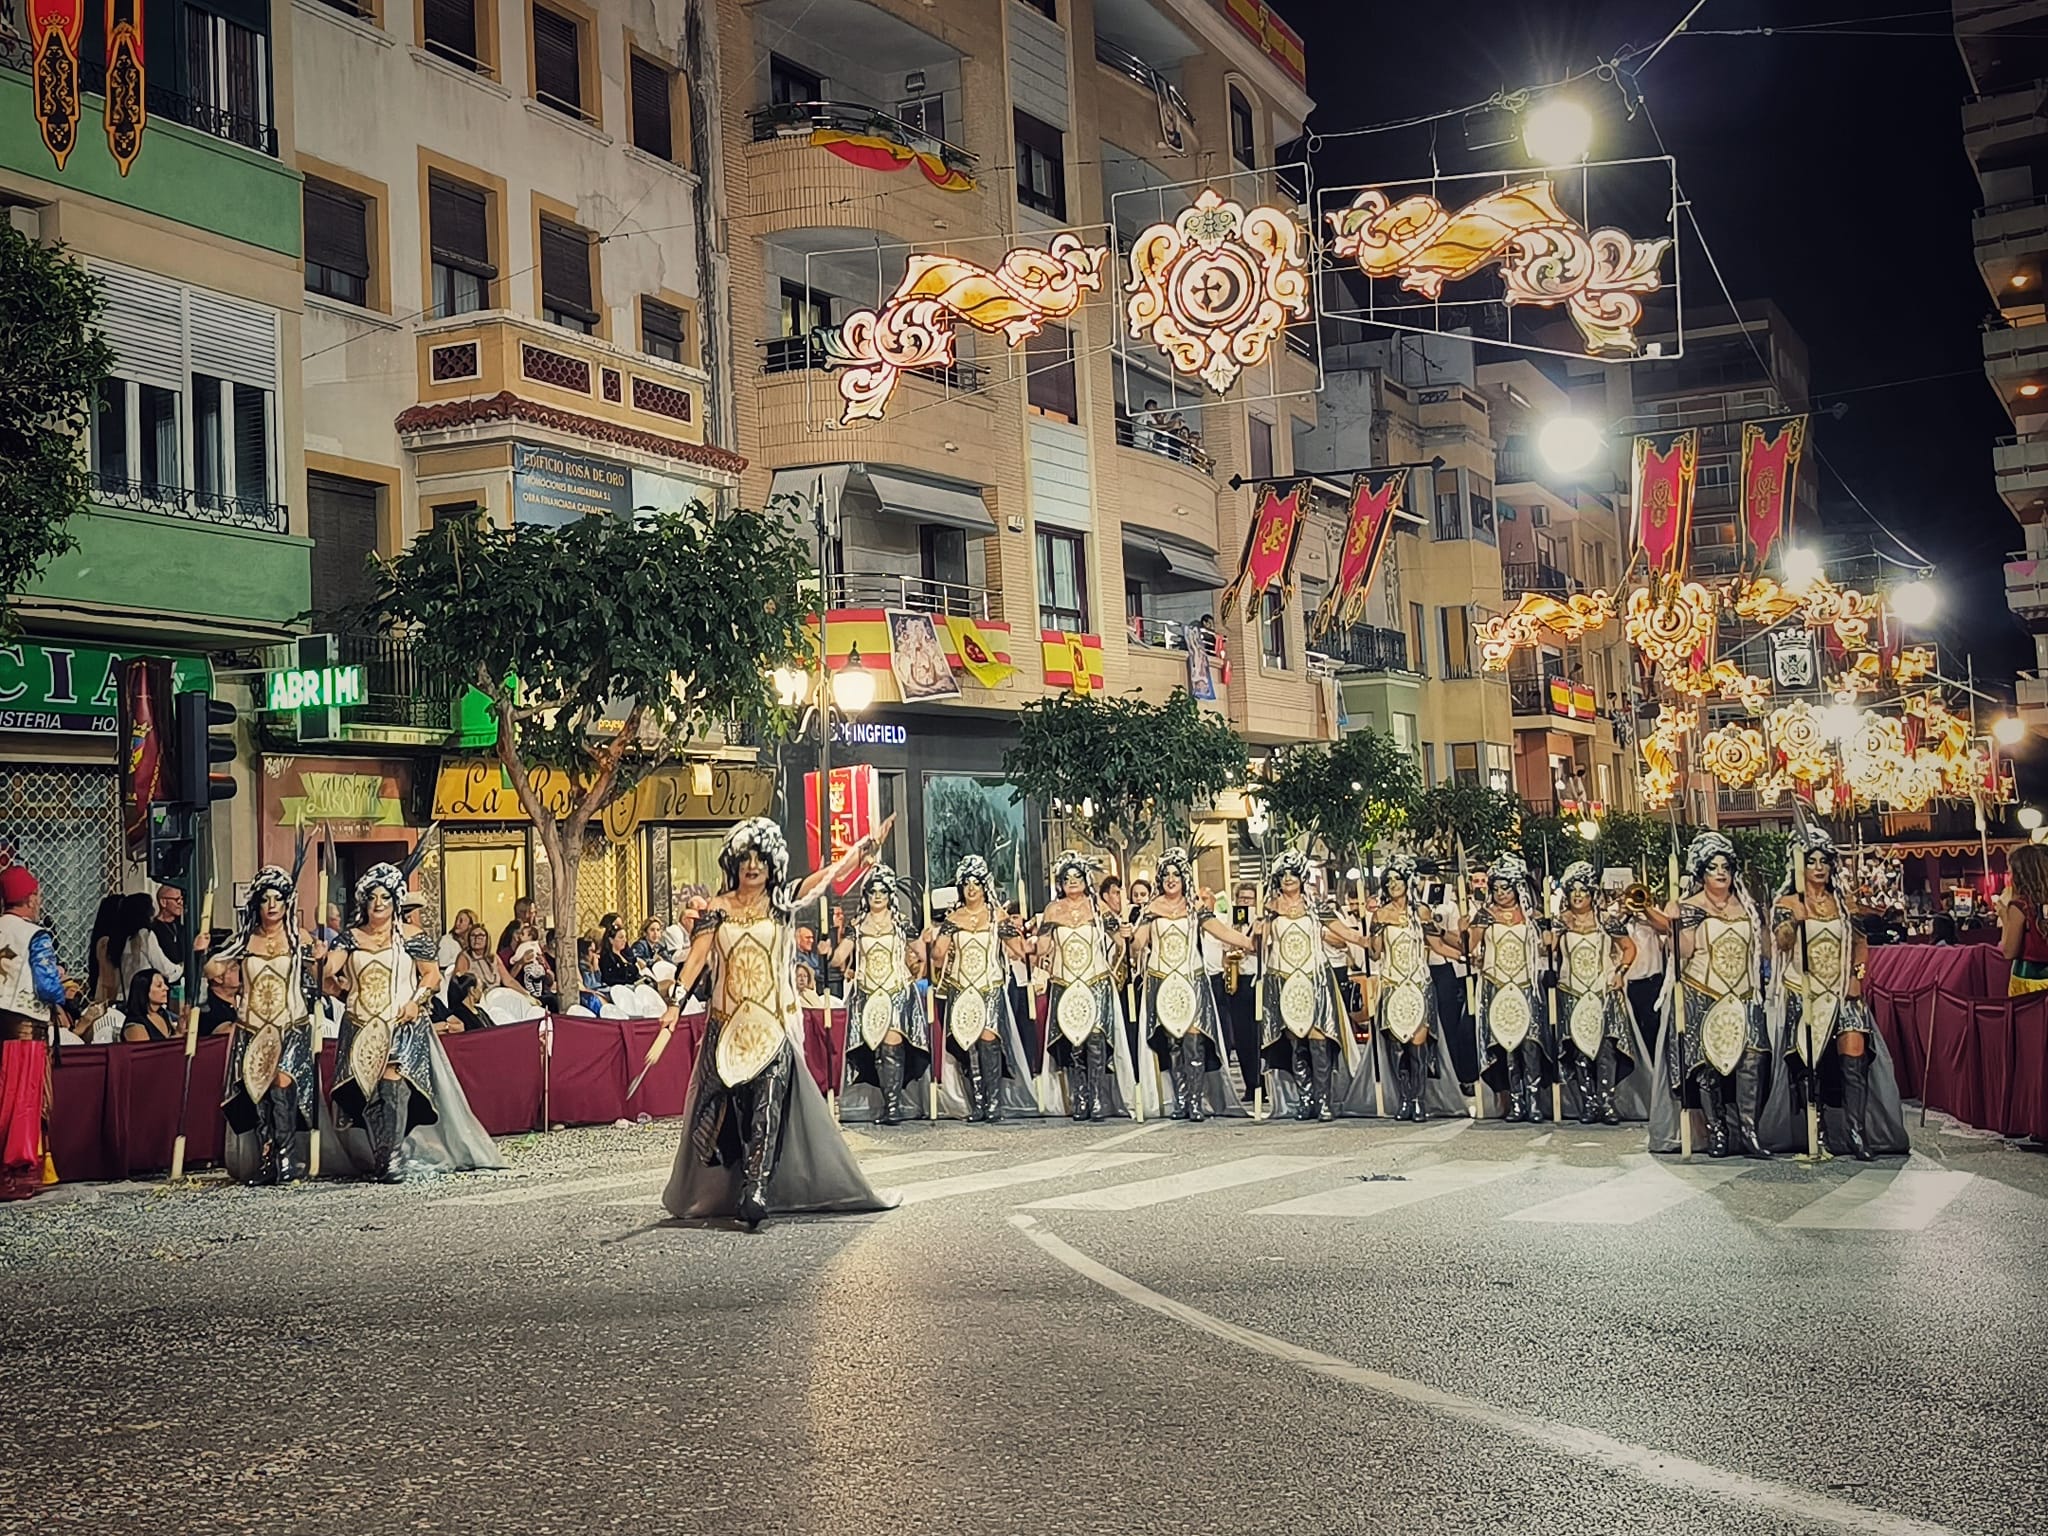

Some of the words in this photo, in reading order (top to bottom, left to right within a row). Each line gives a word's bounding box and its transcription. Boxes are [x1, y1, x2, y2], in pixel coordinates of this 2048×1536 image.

[523, 453, 564, 473] EDIFICIO
[565, 462, 591, 480] ROSA
[592, 468, 605, 482] DE
[606, 473, 625, 487] ORO
[451, 761, 501, 814] La
[663, 777, 688, 816] de
[707, 770, 750, 816] Oro
